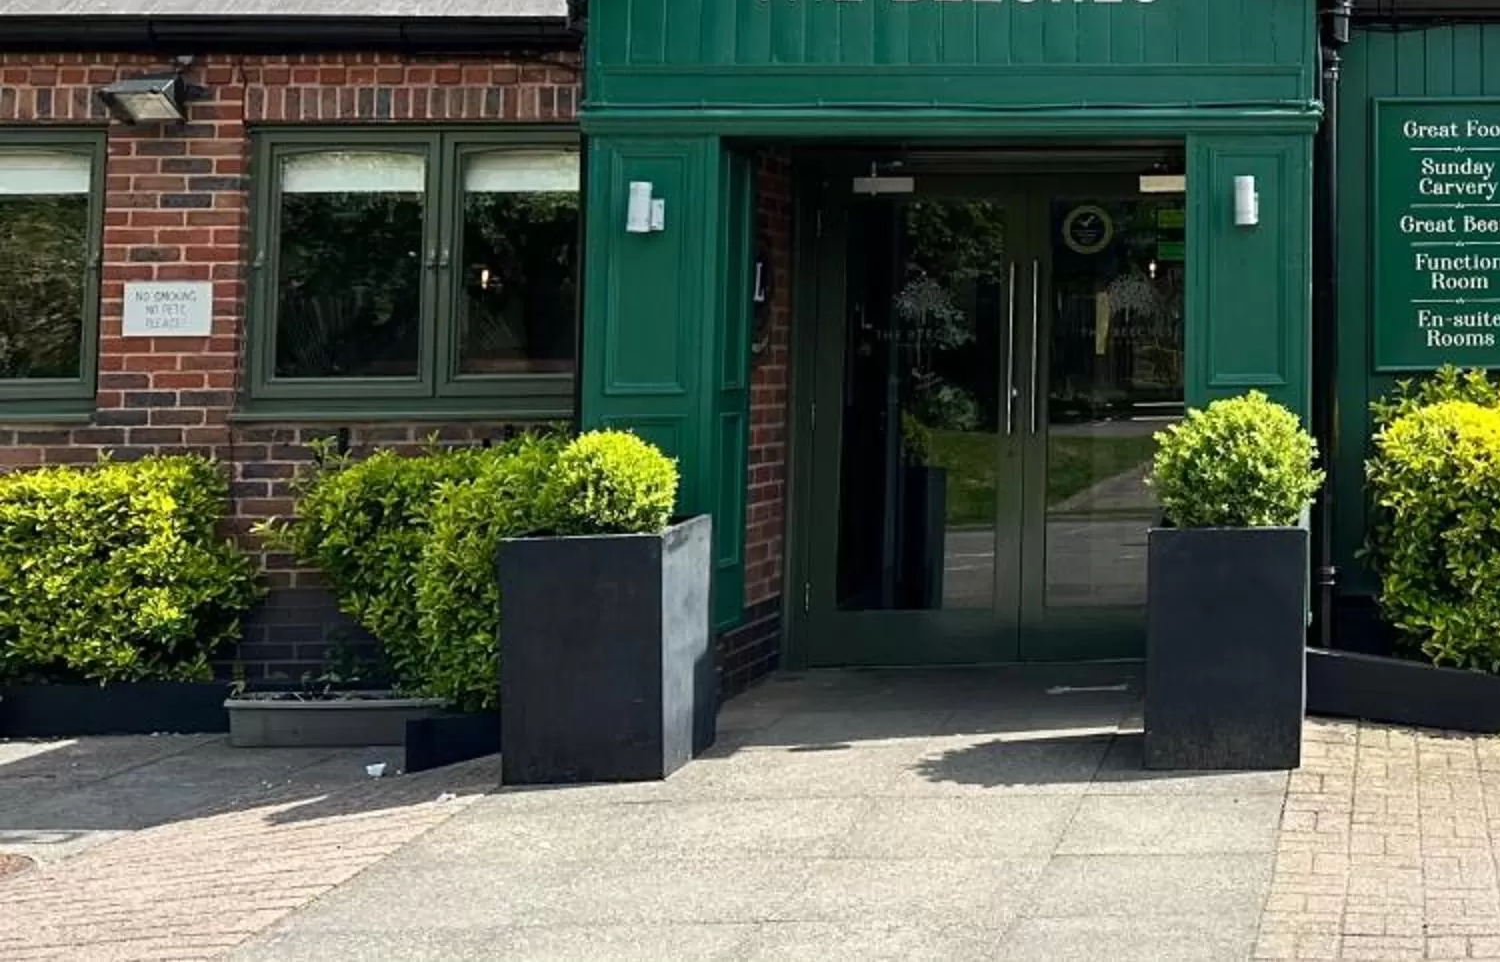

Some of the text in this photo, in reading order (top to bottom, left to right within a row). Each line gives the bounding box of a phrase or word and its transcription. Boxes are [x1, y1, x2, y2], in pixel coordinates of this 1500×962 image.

[1403, 120, 1458, 138] Great
[1421, 157, 1495, 180] Sunday
[1419, 177, 1498, 201] Carvery
[1400, 215, 1455, 233] Great
[1431, 272, 1489, 290] Room
[1427, 329, 1495, 347] Rooms
